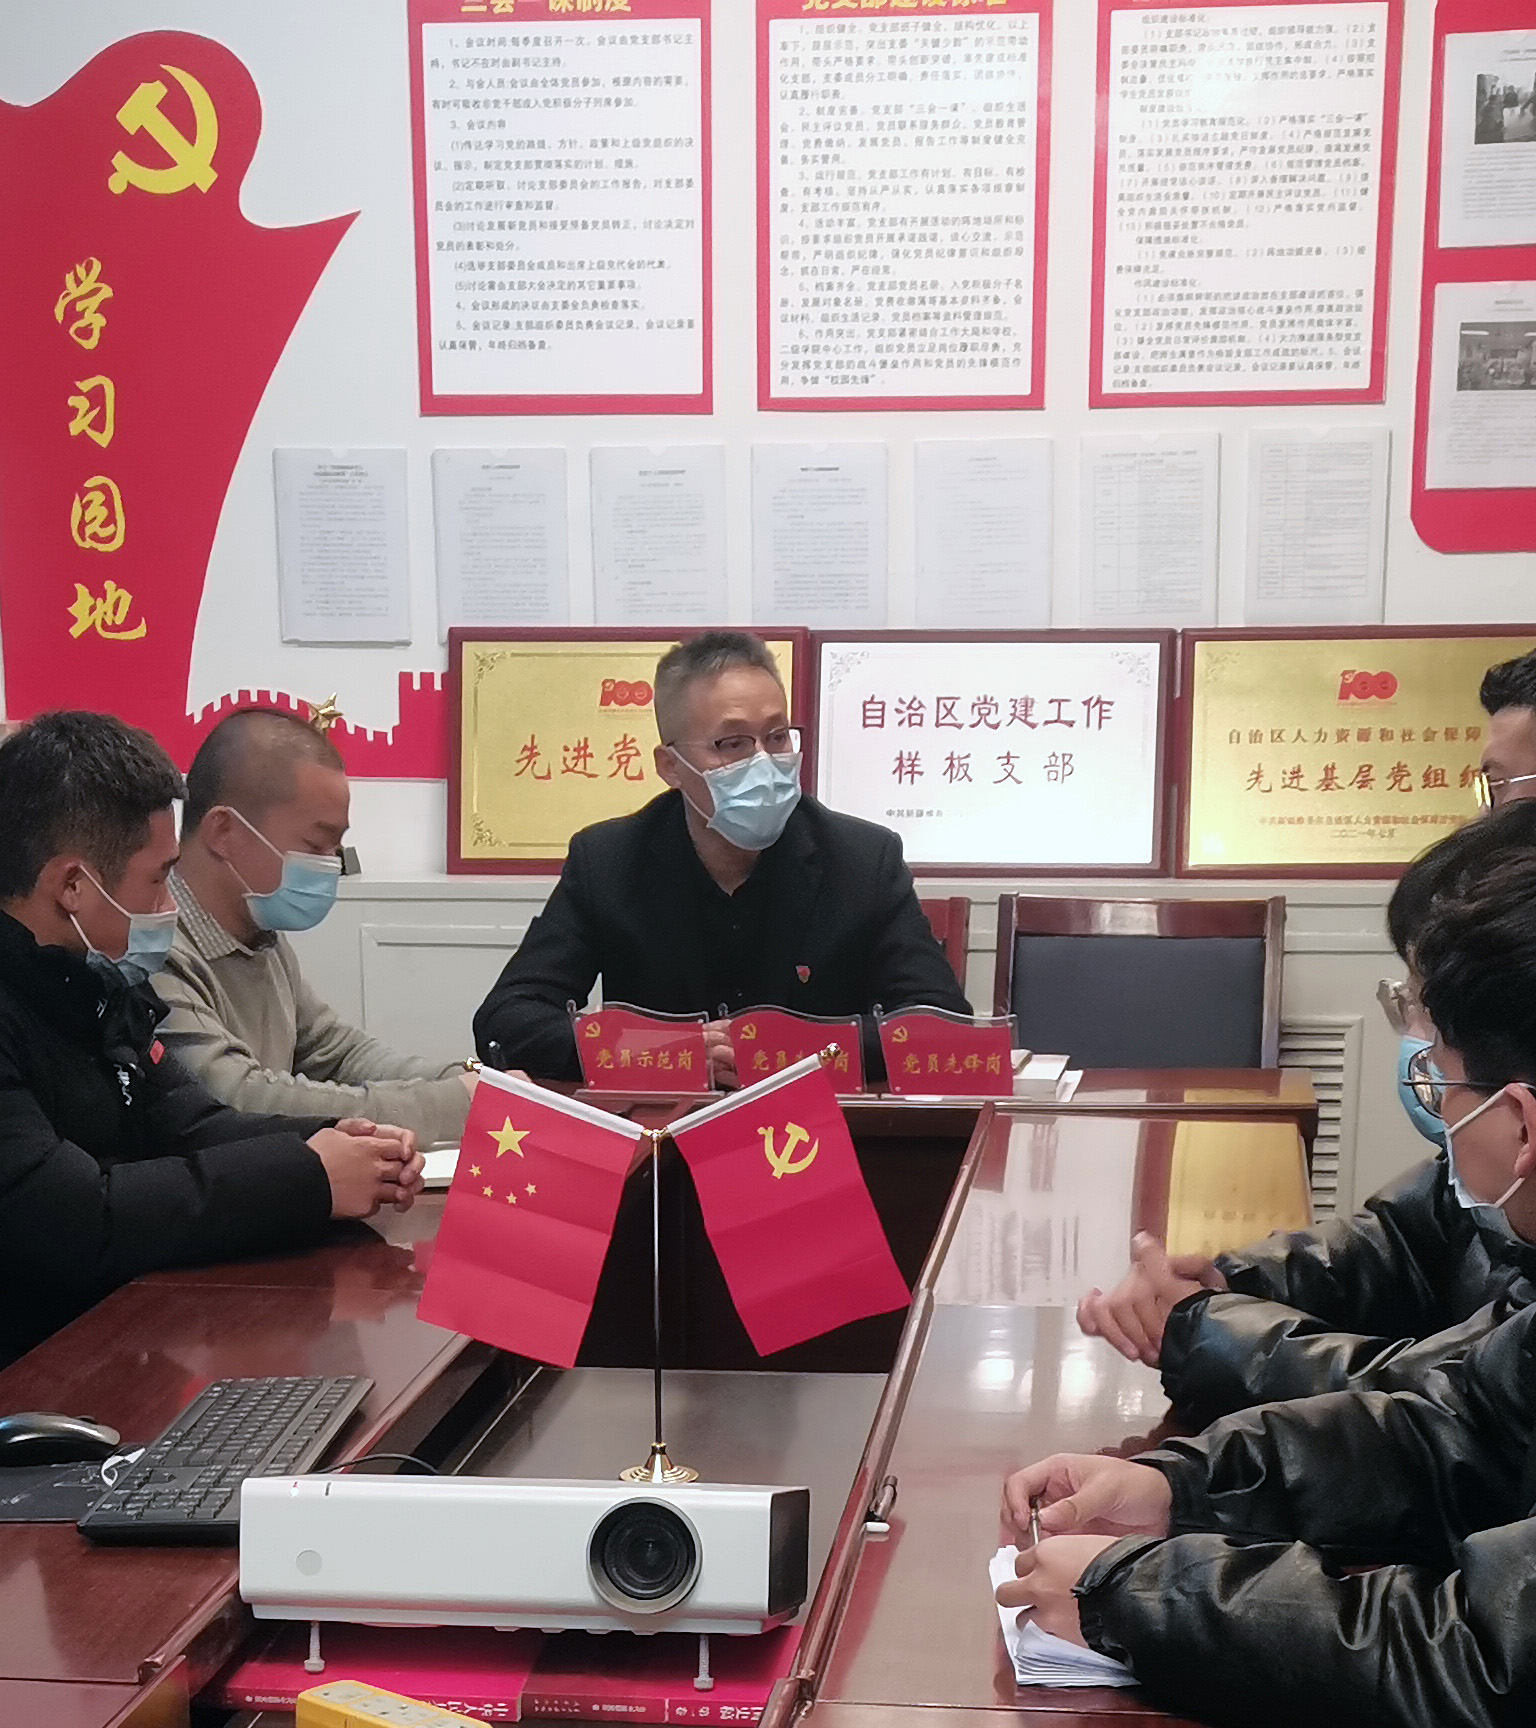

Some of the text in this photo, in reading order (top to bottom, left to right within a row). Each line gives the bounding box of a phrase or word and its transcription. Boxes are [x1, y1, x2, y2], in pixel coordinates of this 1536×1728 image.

[54, 257, 146, 641] 学习园地
[861, 694, 1116, 730] 自治区党建工作
[514, 733, 645, 781] 先进党
[892, 750, 1075, 785] 样板支部
[595, 1049, 694, 1071] 党员示范岗
[752, 1049, 849, 1072] 党员岗
[902, 1053, 1001, 1076] 党员先锋岗
